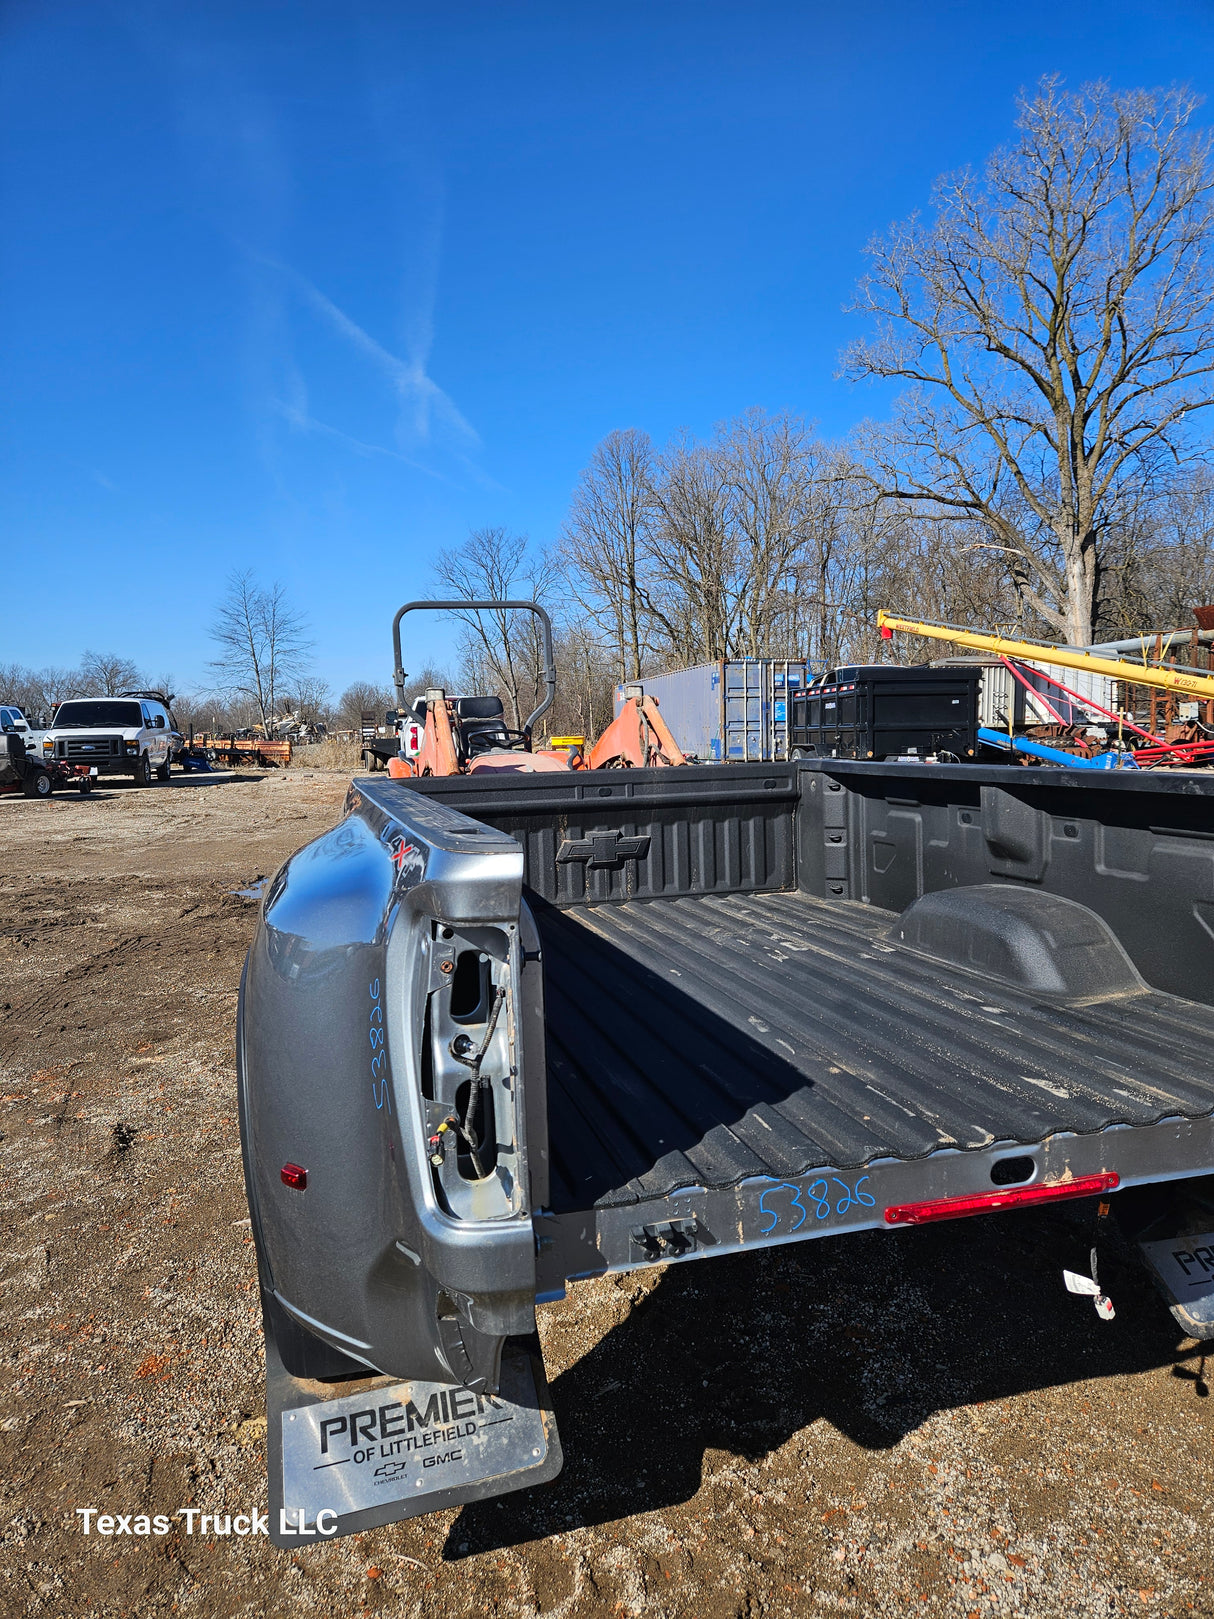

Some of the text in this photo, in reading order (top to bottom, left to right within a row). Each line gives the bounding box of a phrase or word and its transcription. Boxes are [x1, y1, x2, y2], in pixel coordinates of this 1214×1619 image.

[759, 1175, 876, 1233] 53826
[1171, 1245, 1214, 1276] PR
[353, 1422, 477, 1464] OF LITTLEFIELD
[422, 1449, 463, 1469] GMC
[373, 1473, 408, 1486] CHEVROLET
